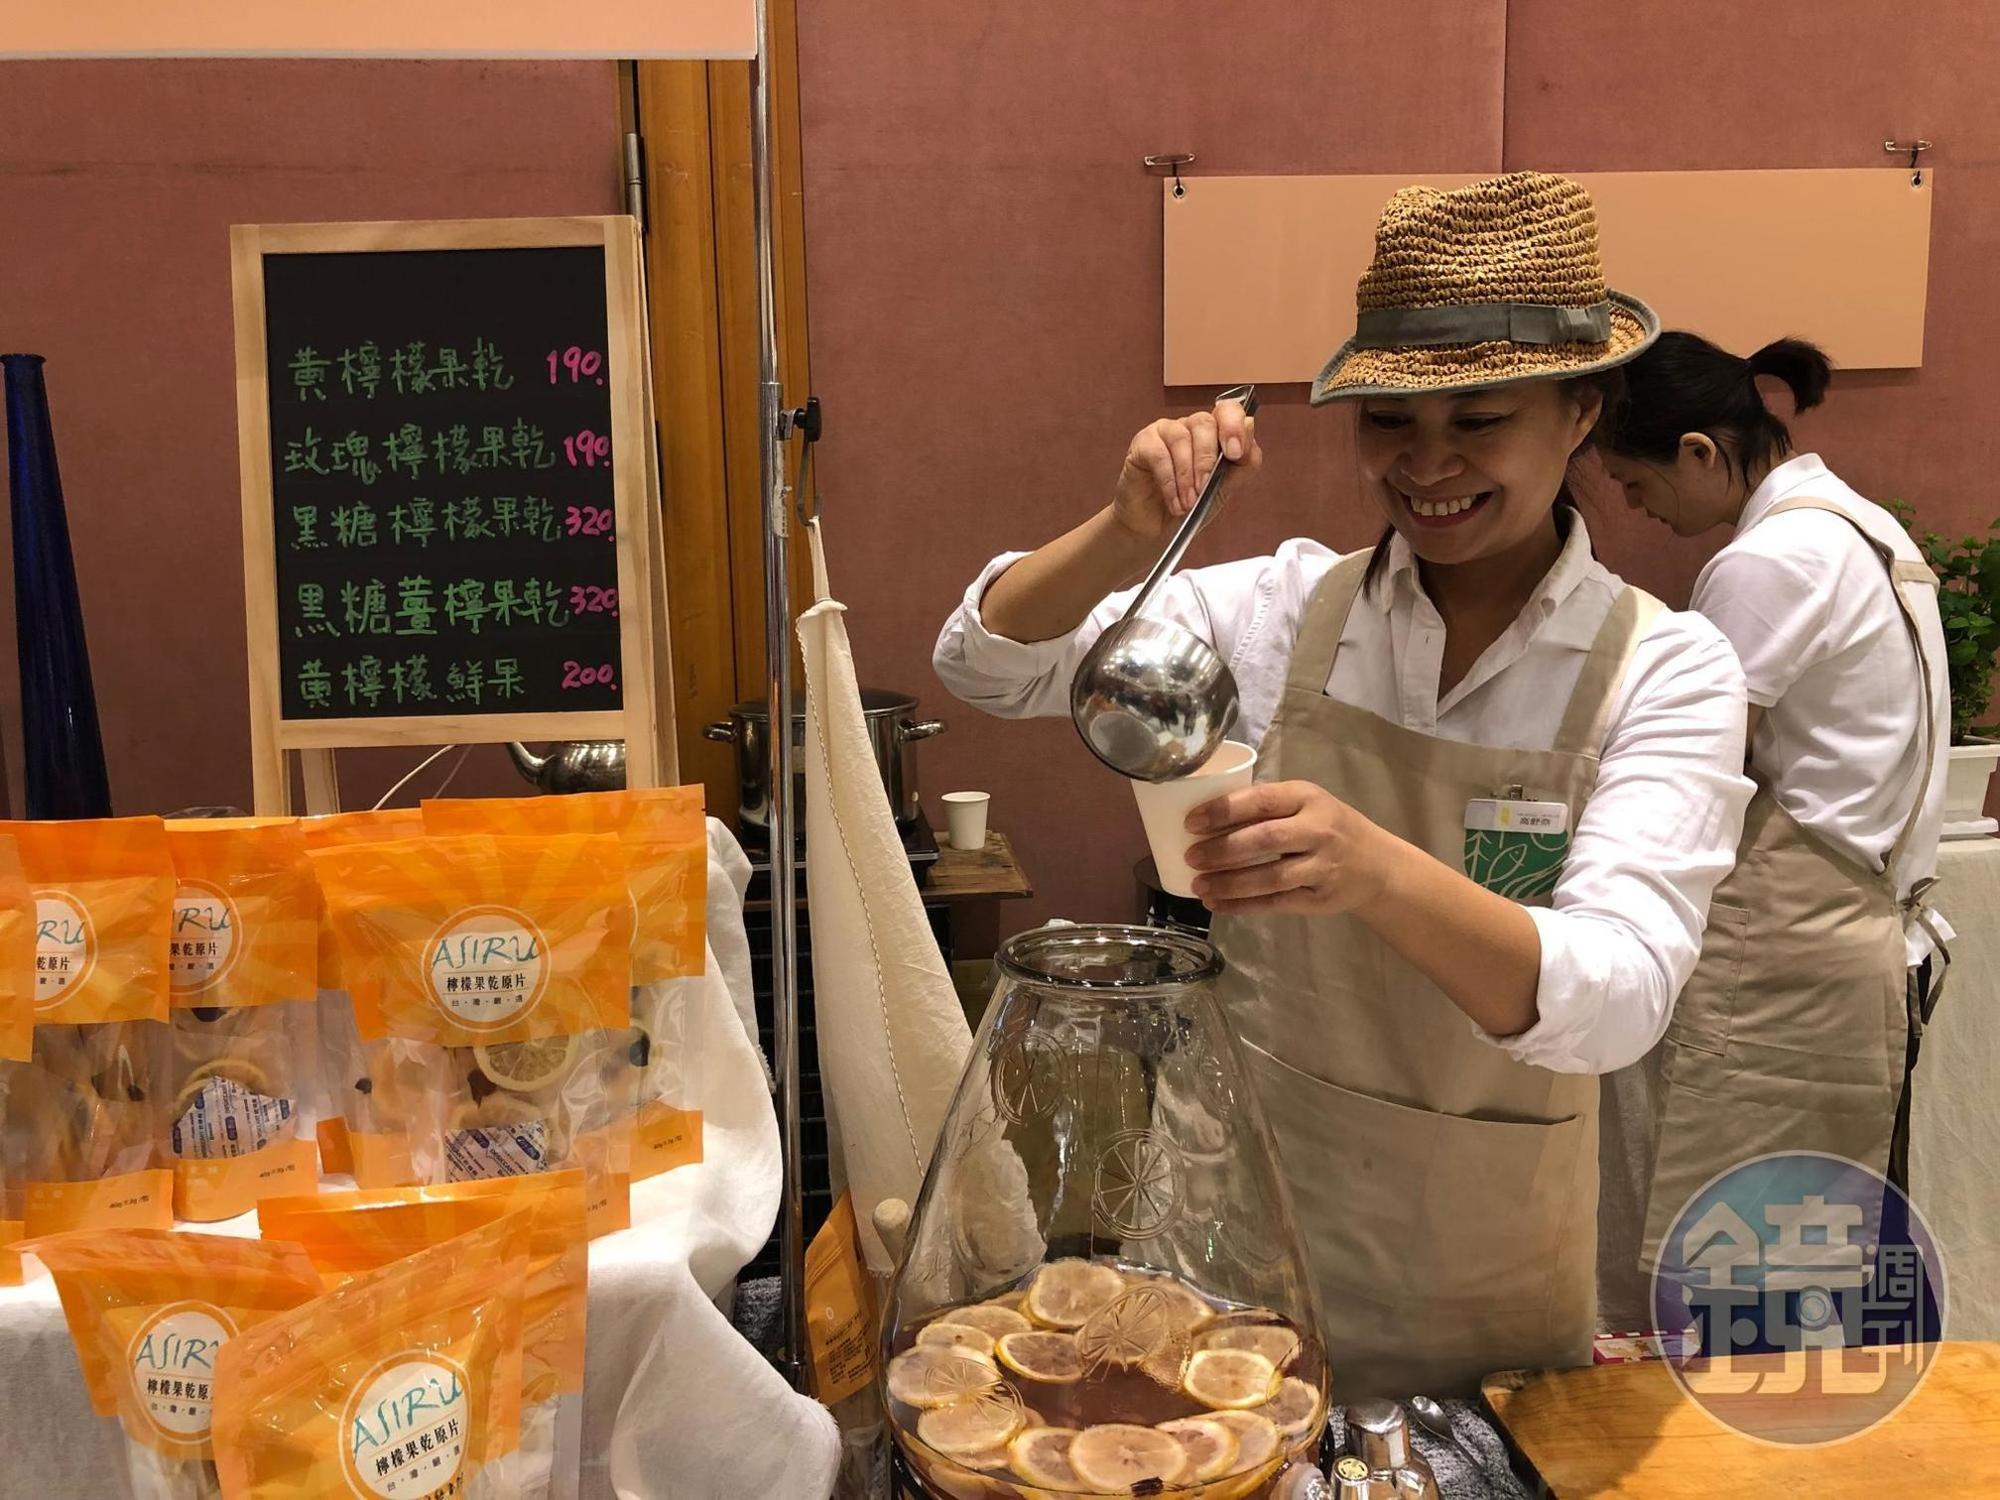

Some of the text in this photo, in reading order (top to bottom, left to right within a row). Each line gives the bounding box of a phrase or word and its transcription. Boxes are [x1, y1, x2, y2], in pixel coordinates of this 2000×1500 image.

[284, 416, 557, 486] 玫瑰檸檬果乾
[289, 496, 562, 549] 黑糖檸檬果乾
[172, 906, 231, 933] RU
[431, 934, 541, 972] ASIRU
[446, 972, 527, 993] 檸檬果乾原片
[135, 1332, 220, 1371] ASIR
[375, 1417, 460, 1477] 檸檬果乾原片
